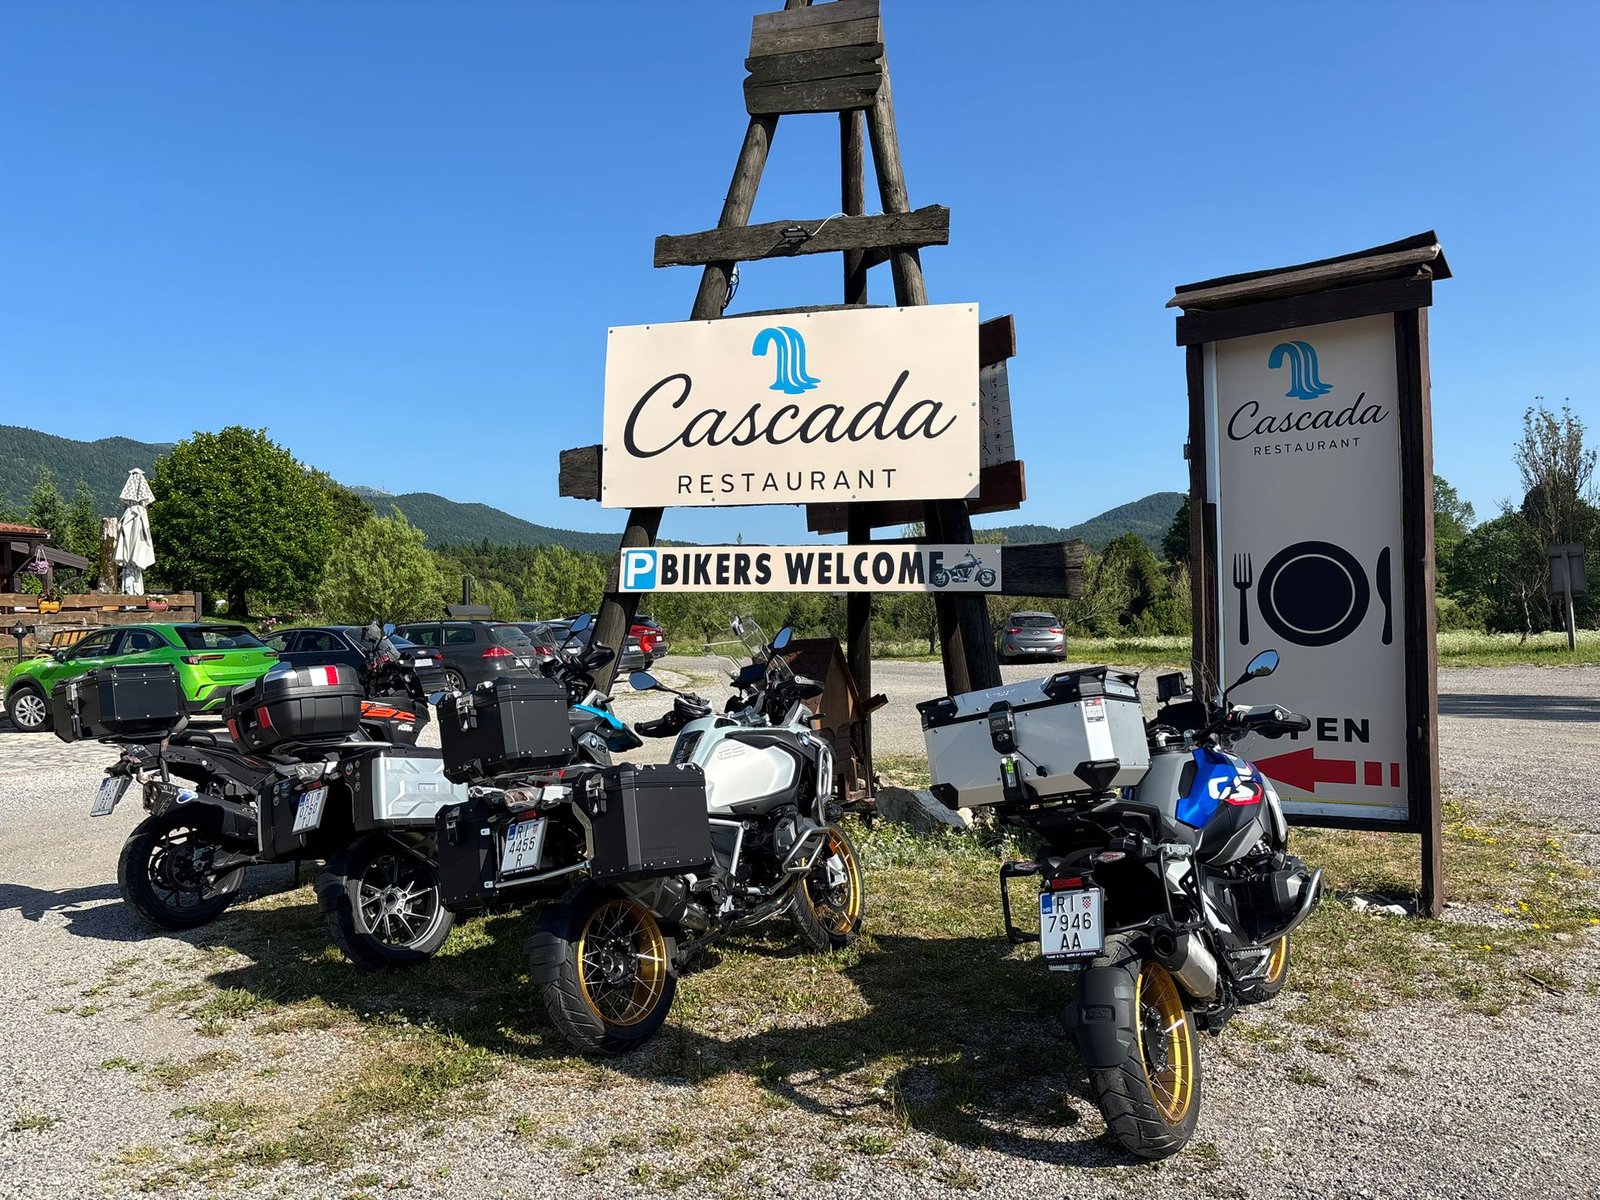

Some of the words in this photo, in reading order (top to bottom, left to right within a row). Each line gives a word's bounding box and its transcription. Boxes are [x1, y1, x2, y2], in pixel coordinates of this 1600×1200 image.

[624, 370, 957, 459] Cascada
[1227, 391, 1390, 441] Cascada
[1253, 437, 1361, 456] RESTAURANT
[678, 468, 897, 494] RESTAURANT
[626, 552, 654, 587] P
[661, 553, 772, 585] BIKERS
[785, 551, 944, 585] WELCOME
[516, 824, 529, 840] RI
[515, 853, 524, 868] R
[1056, 895, 1074, 913] RI
[1048, 912, 1092, 933] 7946
[1060, 932, 1082, 951] AA
